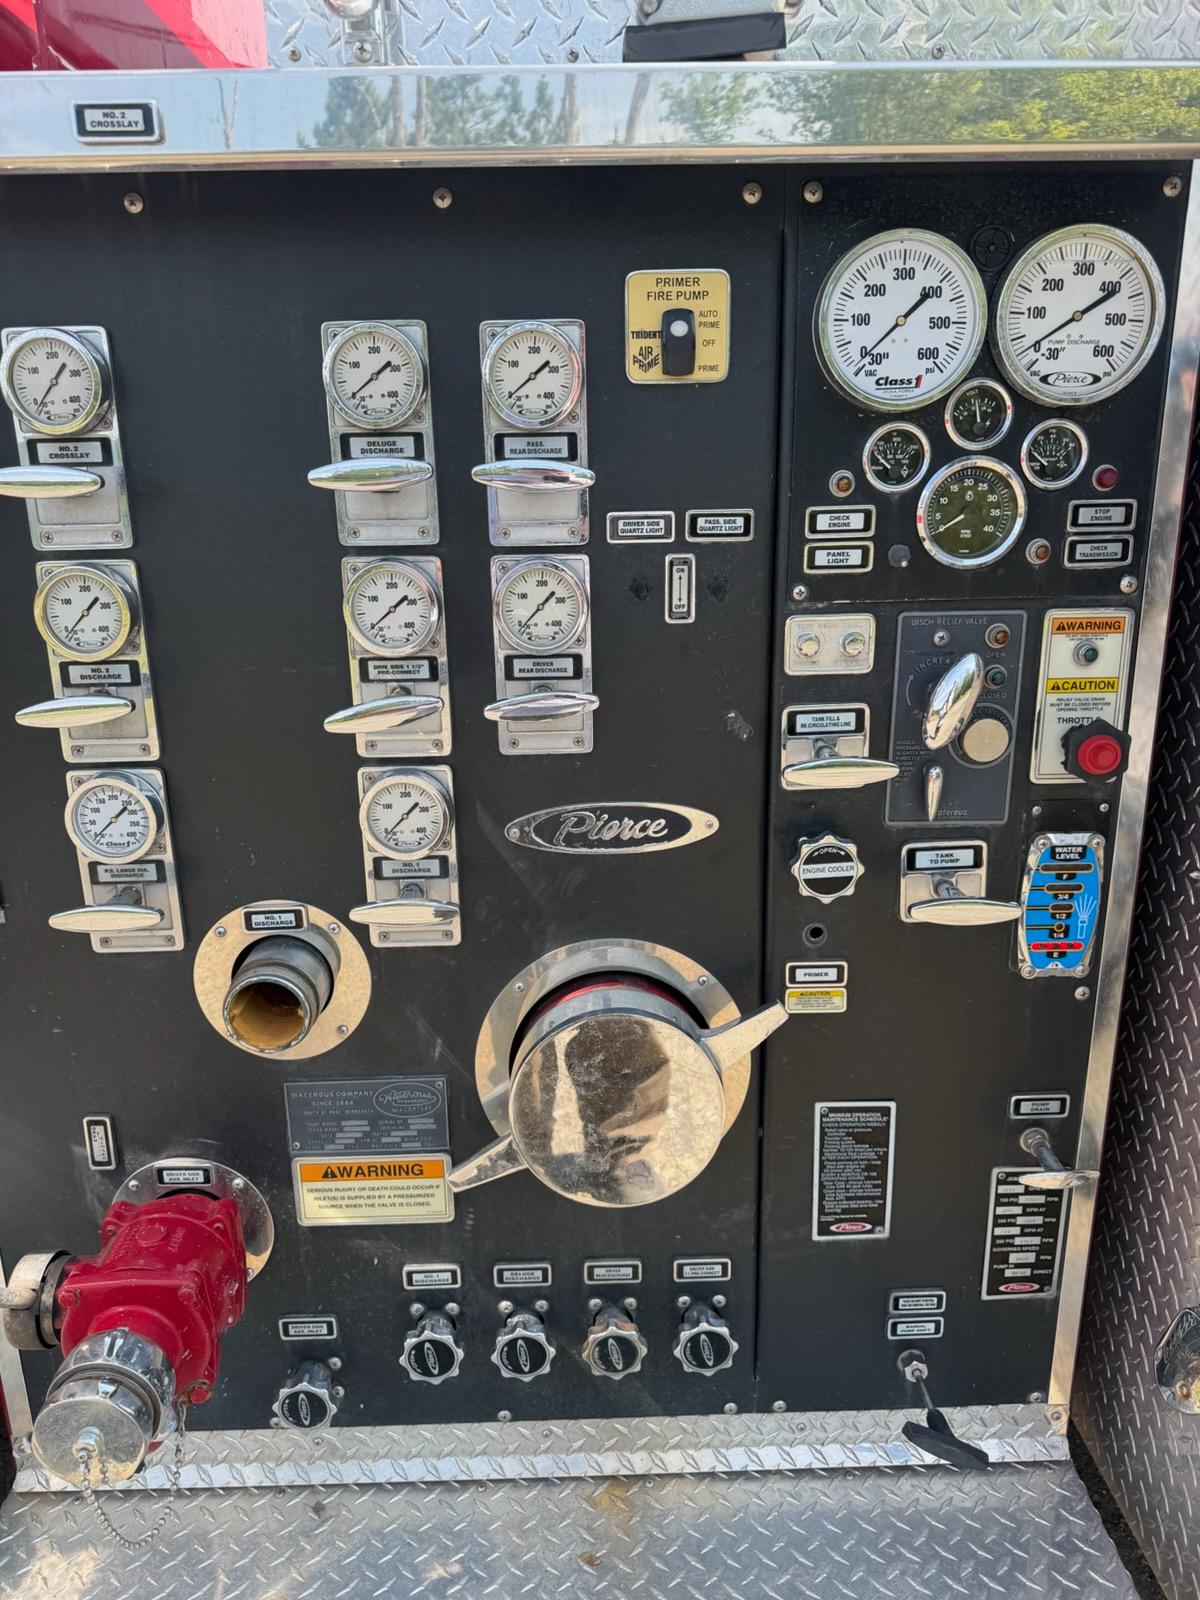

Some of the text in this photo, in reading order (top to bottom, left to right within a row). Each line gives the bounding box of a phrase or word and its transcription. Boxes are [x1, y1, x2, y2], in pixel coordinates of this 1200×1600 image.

[893, 267, 915, 280] 300
[1073, 263, 1095, 276] 300
[656, 277, 700, 287] PRIMER
[1042, 279, 1064, 291] 200
[1100, 281, 1121, 293] 400
[647, 291, 709, 300] FIRE PUMP
[864, 284, 886, 297] 200
[920, 286, 942, 298] 400
[851, 313, 870, 326] 100
[1027, 307, 1046, 319] 100
[1105, 313, 1126, 326] 500
[929, 316, 950, 329] 500
[631, 331, 662, 339] TRIDENT
[639, 346, 653, 360] AIR
[860, 346, 867, 358] 0
[1034, 341, 1040, 352] 0
[1093, 345, 1114, 358] 600
[868, 352, 889, 365] 30"
[918, 347, 939, 360] 600
[633, 354, 659, 373] PRIME
[1053, 373, 1087, 384] Pierce
[1066, 621, 1120, 630] WARNING
[1062, 680, 1114, 690] CAUTION
[554, 810, 668, 846] Pierce
[338, 1164, 423, 1177] WARNING
